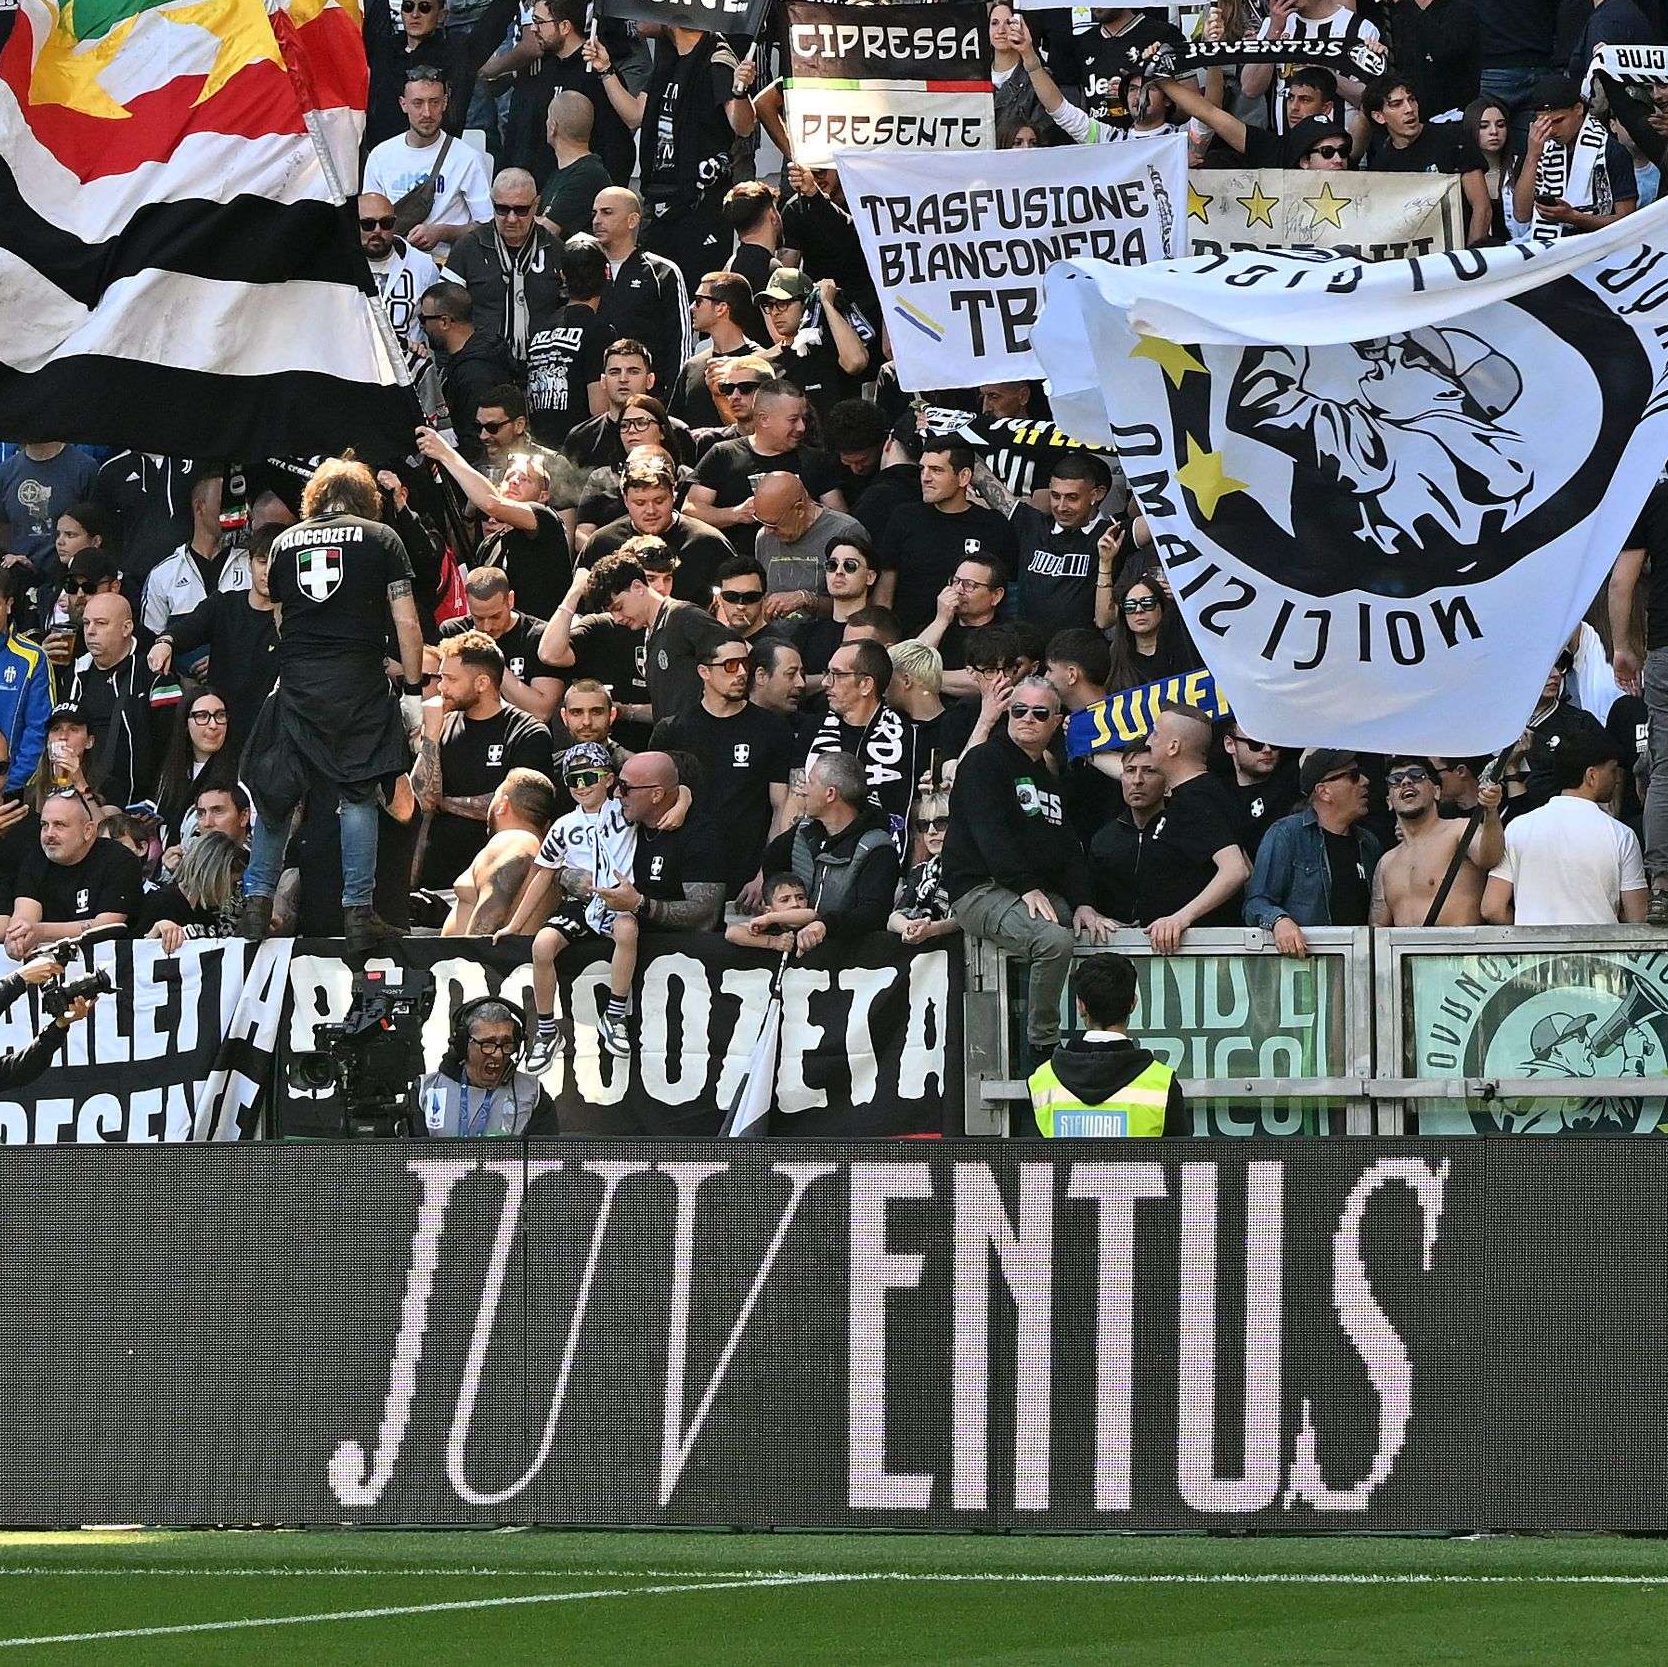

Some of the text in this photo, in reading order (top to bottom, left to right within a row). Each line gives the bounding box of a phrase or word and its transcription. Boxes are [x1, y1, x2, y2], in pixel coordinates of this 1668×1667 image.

[792, 25, 981, 60] CIPRESSA
[1184, 40, 1341, 58] JUVENTUS
[802, 114, 981, 149] PRESENTE
[862, 183, 1148, 235] TRASFUSIONE
[281, 526, 364, 551] BLOCCOZETA
[329, 1156, 1449, 1511] JUVENTUS
